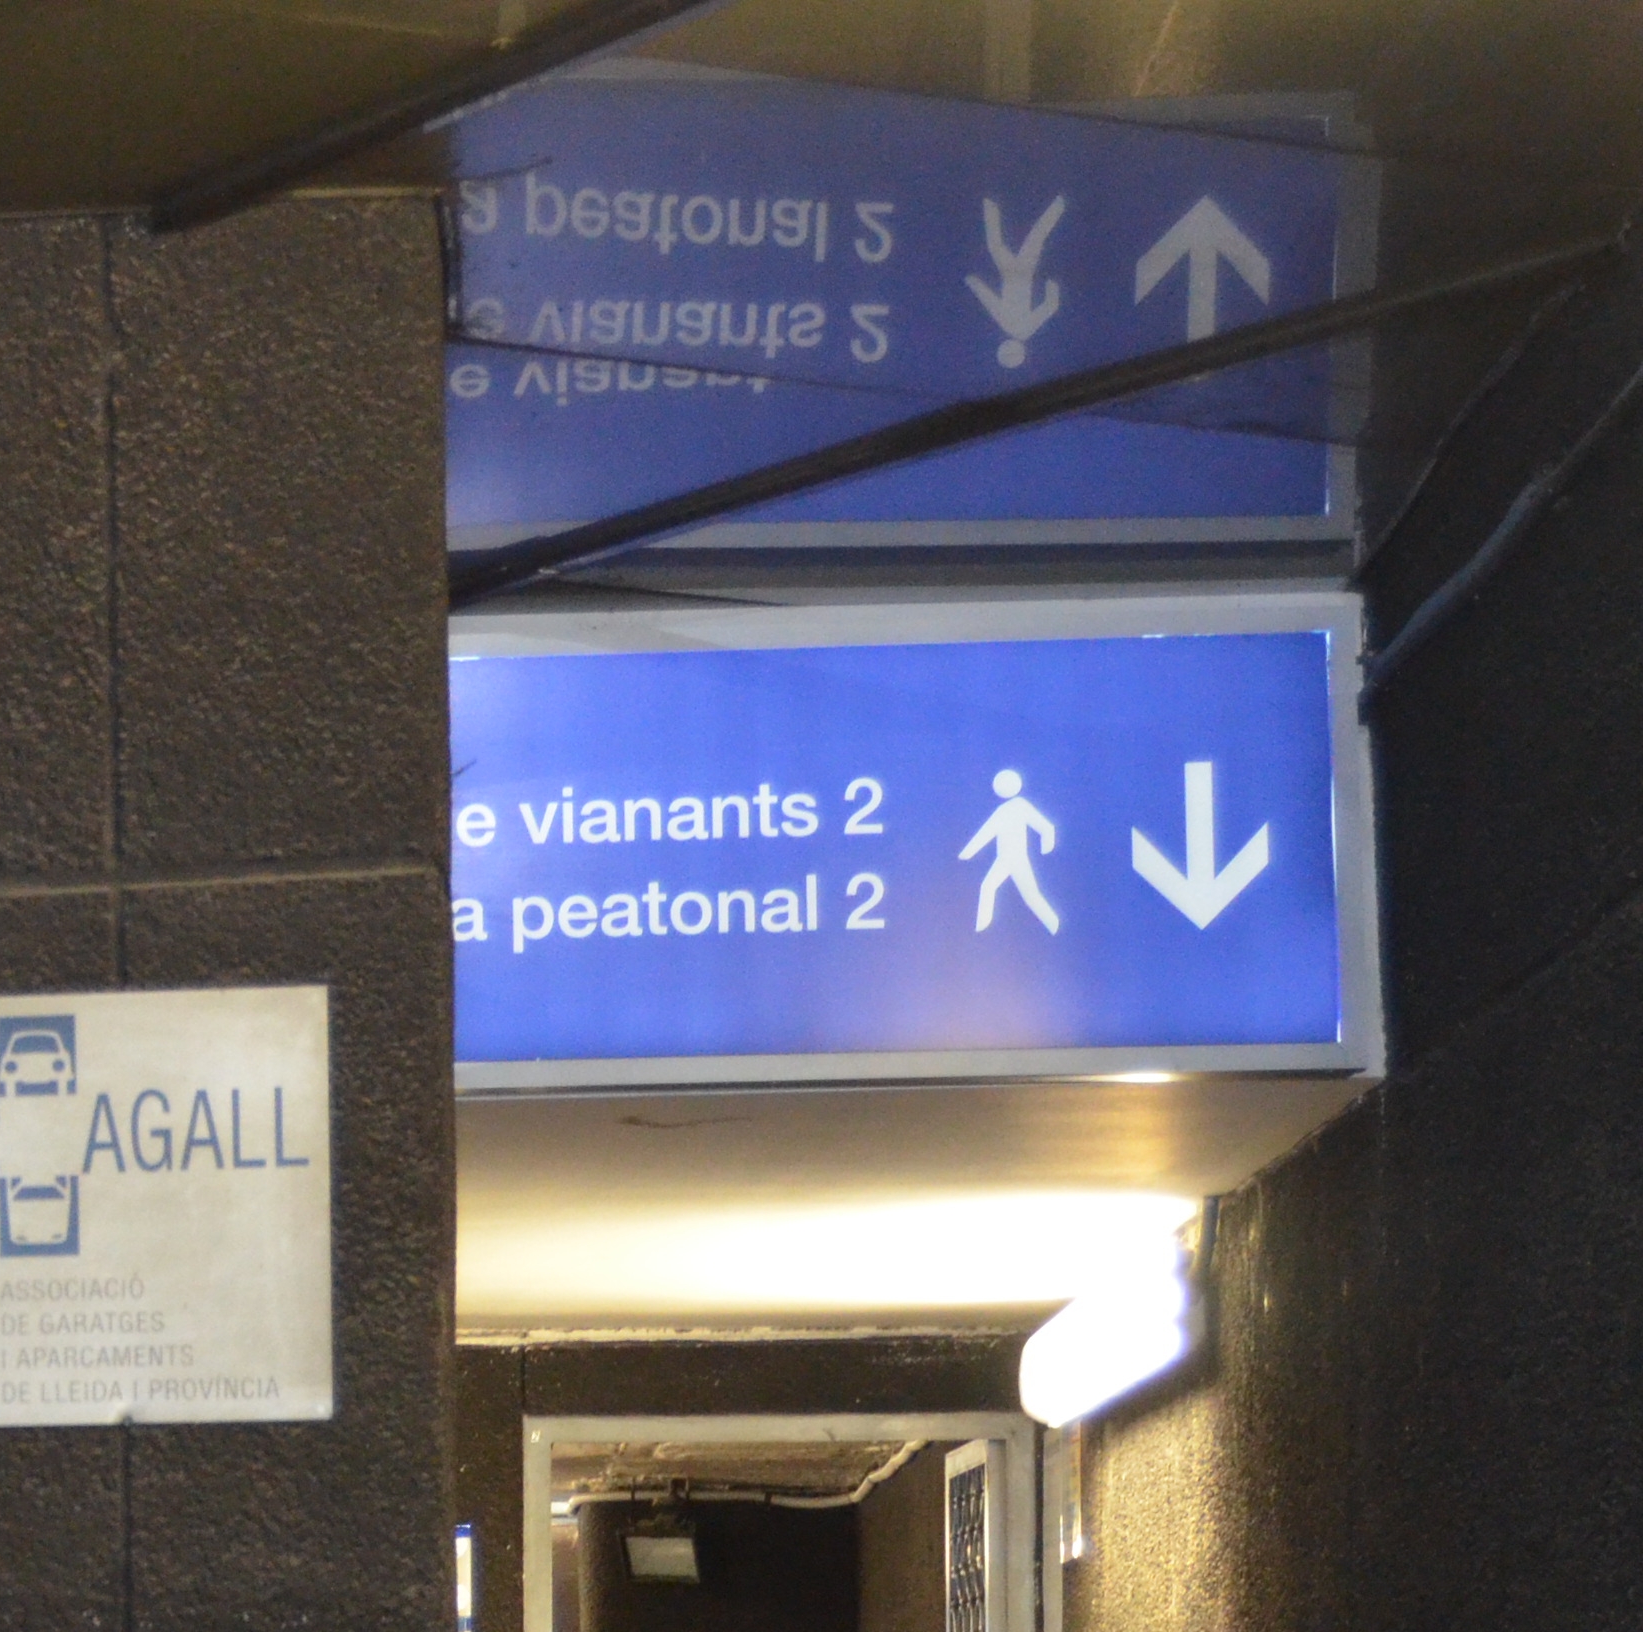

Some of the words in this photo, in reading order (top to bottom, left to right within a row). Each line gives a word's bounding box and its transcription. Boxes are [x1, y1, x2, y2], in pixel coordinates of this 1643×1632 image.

[519, 783, 819, 844] vianants
[843, 777, 885, 836] 2
[512, 873, 818, 954] peatonal
[845, 872, 886, 931] 2
[81, 1085, 310, 1174] AGALL
[0, 1272, 145, 1302] ASSOCIACIÓ
[0, 1312, 29, 1336] DE
[39, 1311, 166, 1335] GARATGES
[17, 1344, 195, 1370] APARCAMENTS
[1, 1381, 30, 1404] DE
[40, 1379, 124, 1403] LLEIDA
[149, 1375, 282, 1402] PROVÍNCIA
